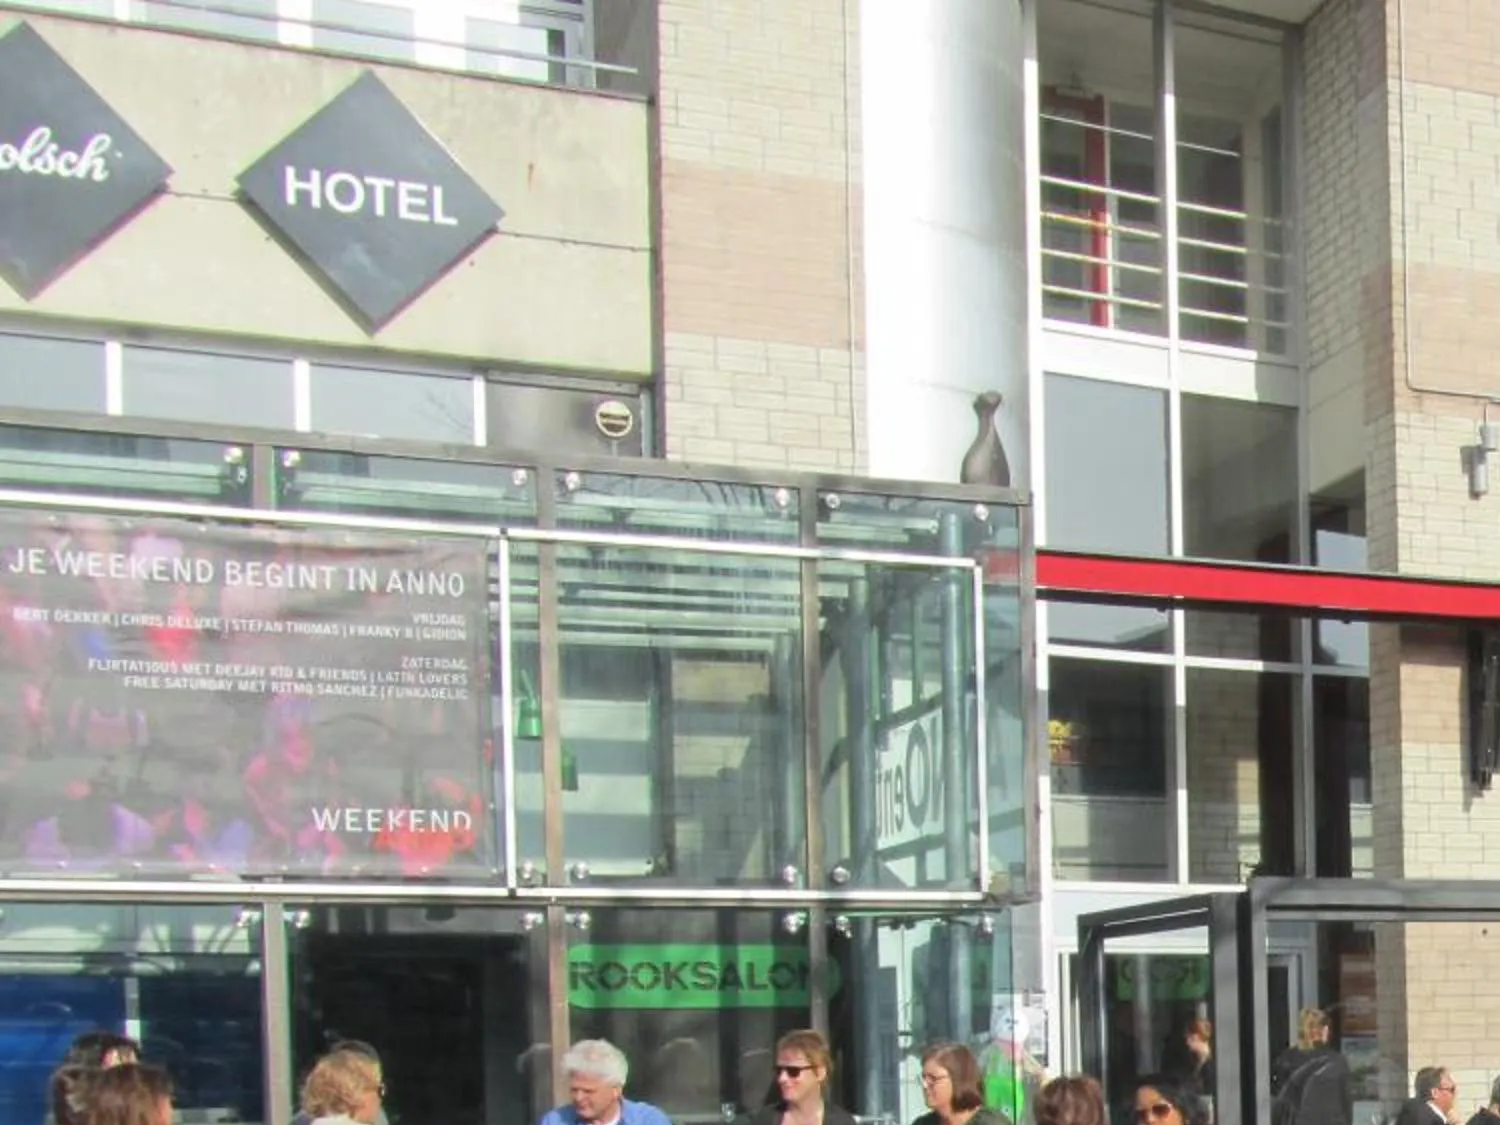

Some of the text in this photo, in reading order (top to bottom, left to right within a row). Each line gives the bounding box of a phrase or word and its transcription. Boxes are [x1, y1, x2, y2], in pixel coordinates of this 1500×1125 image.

[285, 165, 459, 226] HOTEL
[9, 547, 464, 598] JE WEEKEND BEGINT IN ANNO
[311, 807, 473, 833] WEEKEND
